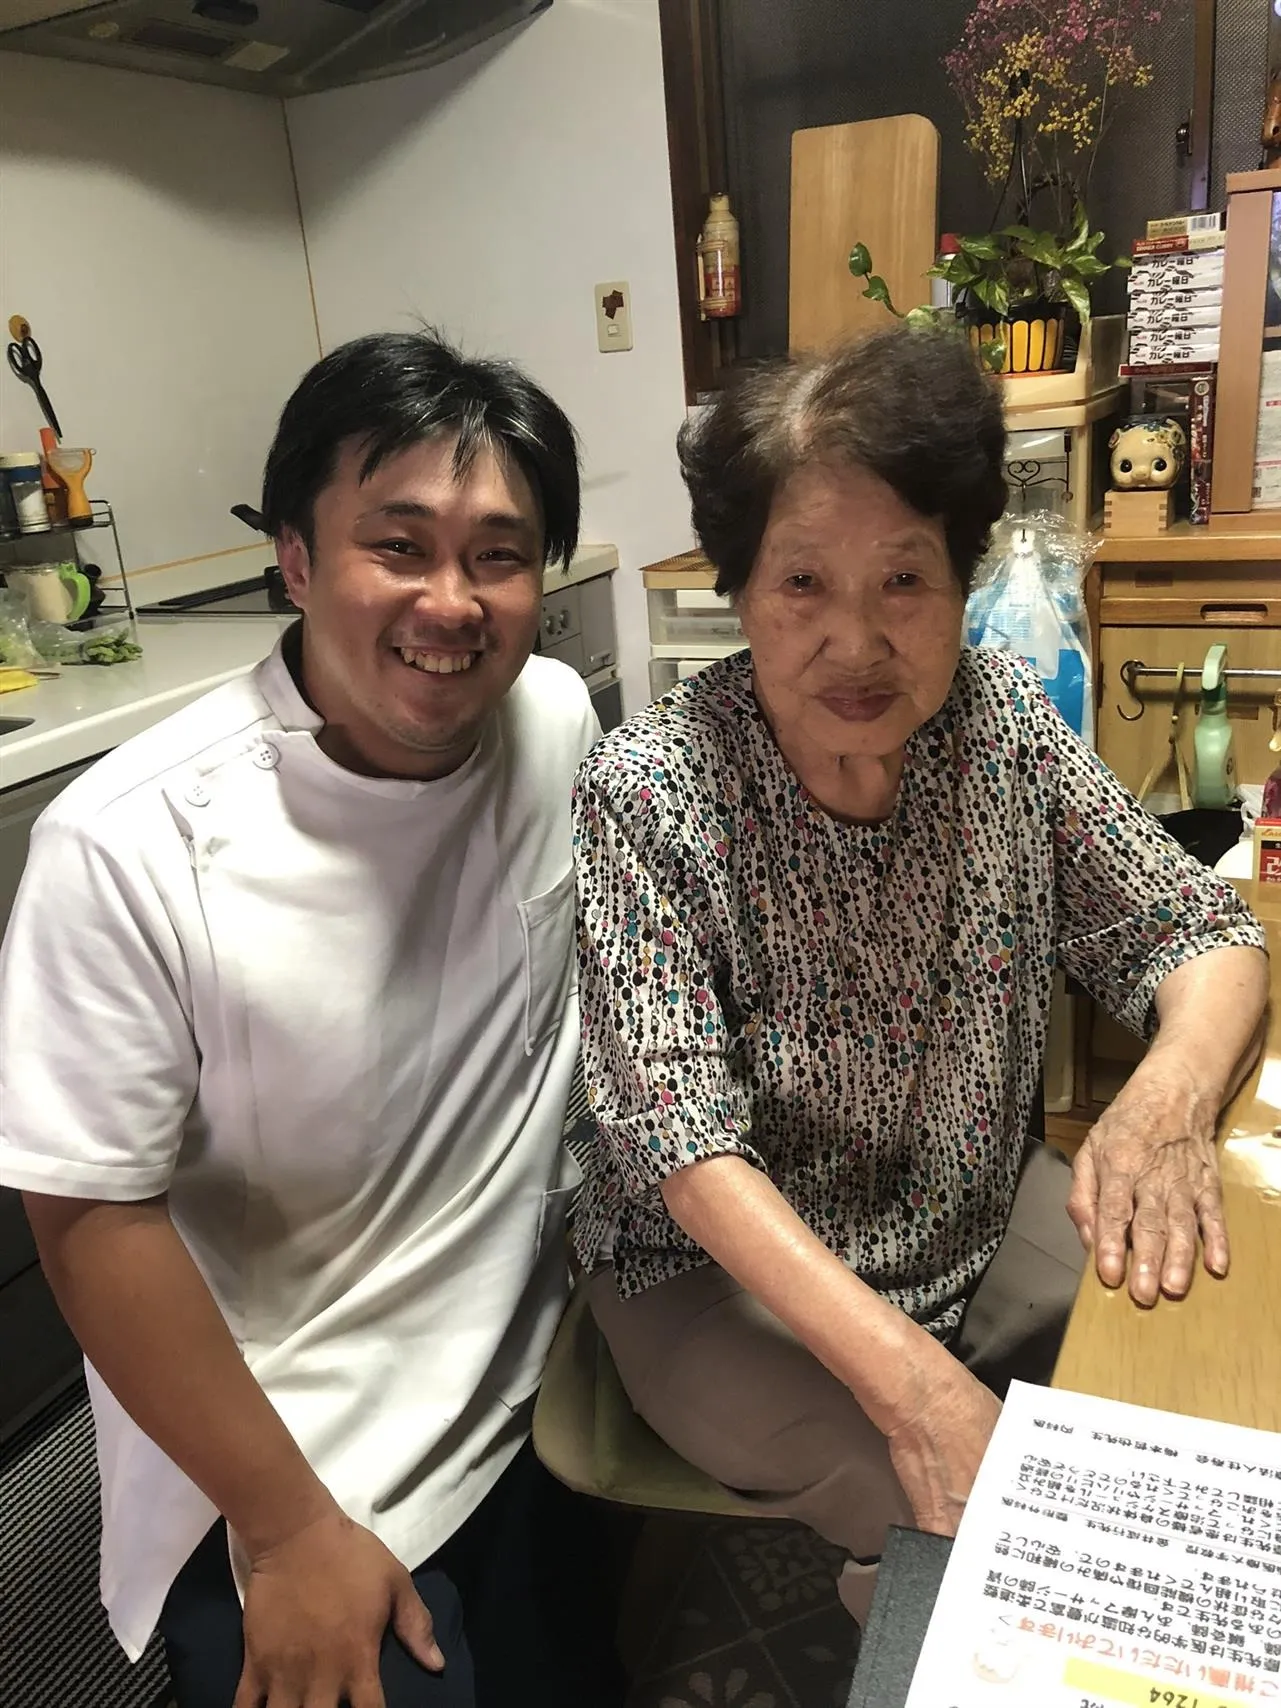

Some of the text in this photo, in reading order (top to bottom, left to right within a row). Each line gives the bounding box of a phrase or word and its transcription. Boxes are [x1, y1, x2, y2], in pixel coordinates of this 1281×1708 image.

[1152, 255, 1194, 269] カレー曜日
[1147, 274, 1189, 288] カレー曜日
[1150, 293, 1192, 306] カレー曜日
[1147, 312, 1188, 325] カレー曜日
[1150, 331, 1191, 343] カレー曜日
[1149, 349, 1190, 361] カレー曜日
[1185, 1545, 1281, 1575] 医療大学教授
